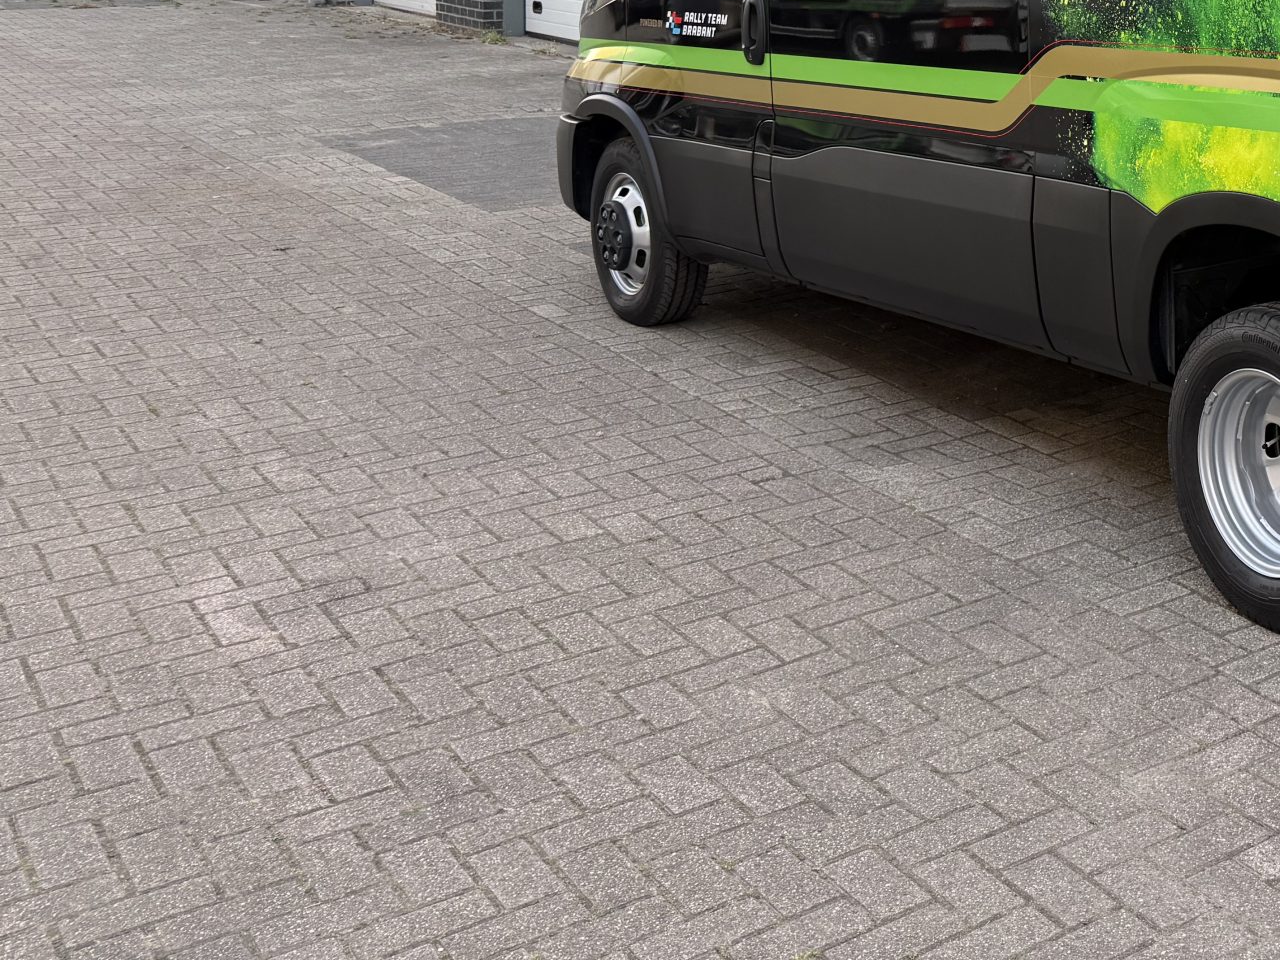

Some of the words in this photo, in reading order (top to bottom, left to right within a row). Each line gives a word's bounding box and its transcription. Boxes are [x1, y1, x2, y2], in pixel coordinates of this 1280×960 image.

[683, 12, 706, 24] RALLY
[707, 14, 728, 25] TEAM
[682, 25, 716, 38] BRABANT
